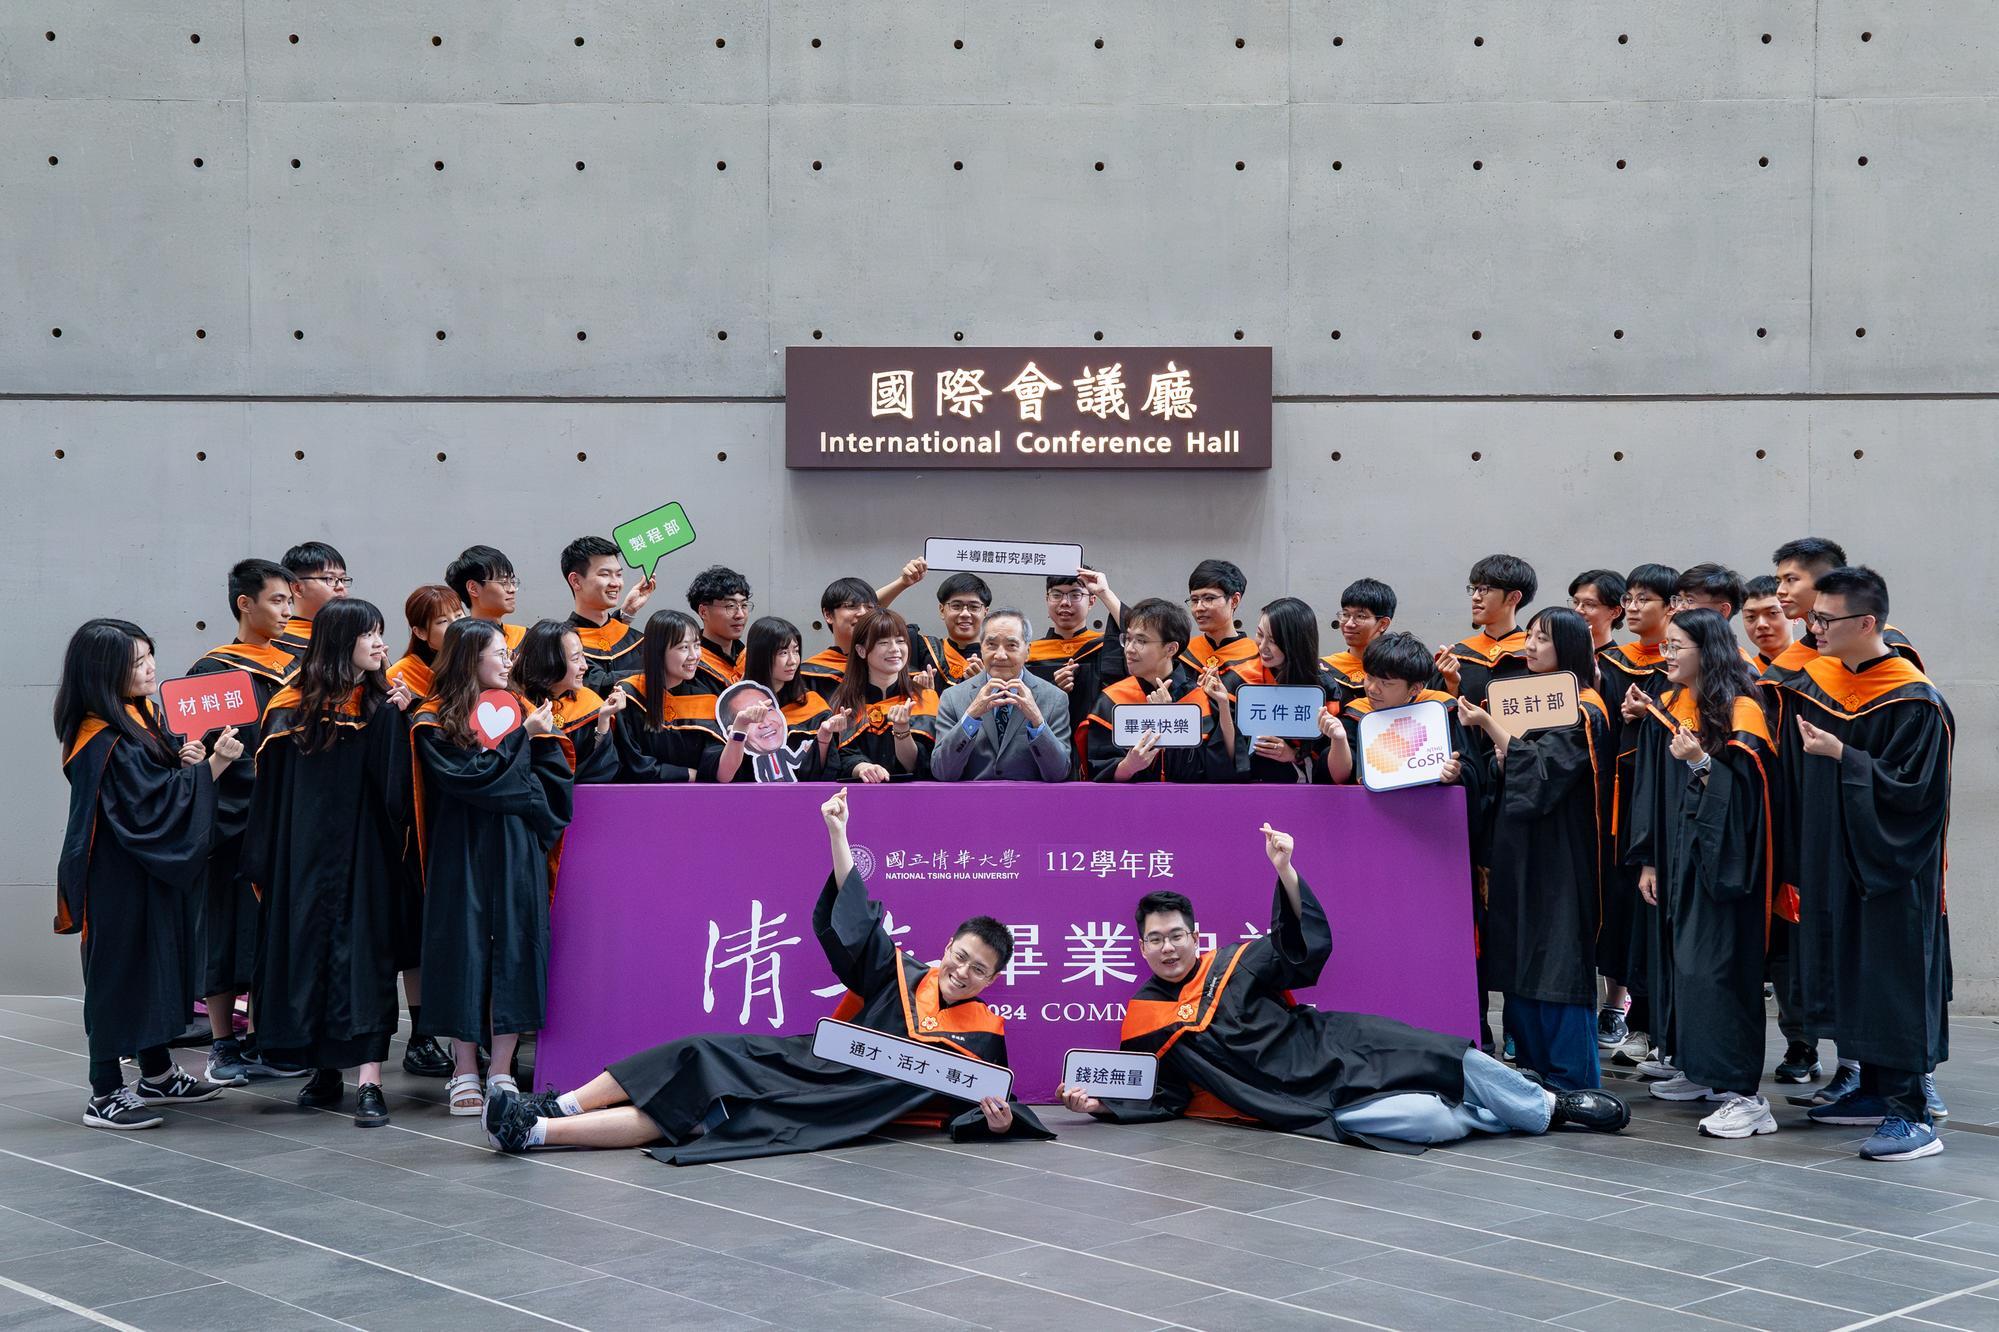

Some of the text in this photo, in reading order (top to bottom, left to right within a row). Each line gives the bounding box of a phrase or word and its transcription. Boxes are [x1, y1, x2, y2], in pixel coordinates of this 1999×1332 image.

[870, 361, 1198, 421] 國際會議廳
[820, 430, 1239, 454] International Conference Hall
[629, 520, 680, 552] 製程部
[956, 549, 1047, 566] 半導體研究學院
[178, 690, 243, 716] 材料部
[1250, 703, 1311, 722] 元件部
[1502, 692, 1565, 716] 設計部
[1124, 718, 1189, 734] 畢業快樂
[1407, 752, 1446, 769] CoSR
[885, 848, 1021, 870] 國立清華大學
[1046, 849, 1175, 879] 112學年度
[885, 872, 1020, 880] NATIONAL TSING HUA UNIVERSITY
[986, 1004, 1027, 1020] 024
[849, 1040, 979, 1088] 通才、活才、專才
[1075, 1066, 1144, 1087] 錢途無量
